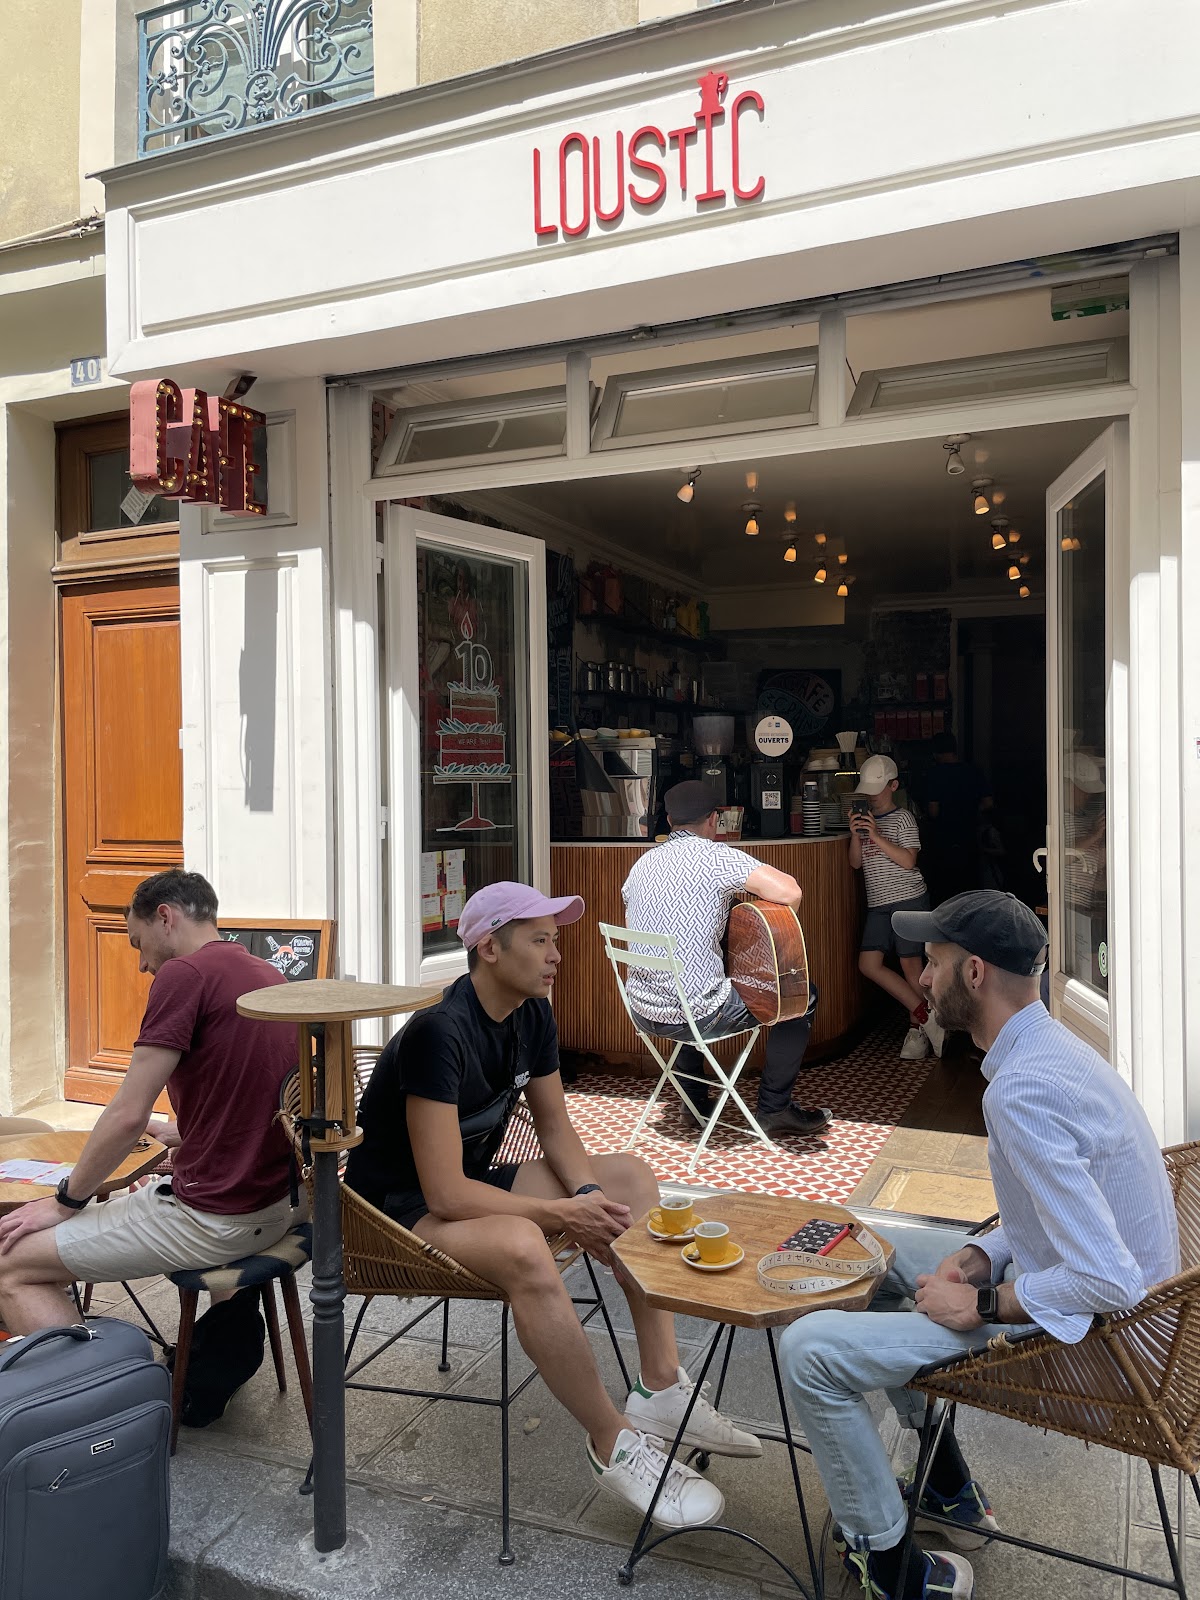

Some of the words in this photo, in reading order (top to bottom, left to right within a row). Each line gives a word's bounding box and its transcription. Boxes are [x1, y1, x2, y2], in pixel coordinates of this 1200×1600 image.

[533, 90, 765, 235] LOUSTIC
[76, 359, 97, 381] 40
[455, 640, 493, 691] 10
